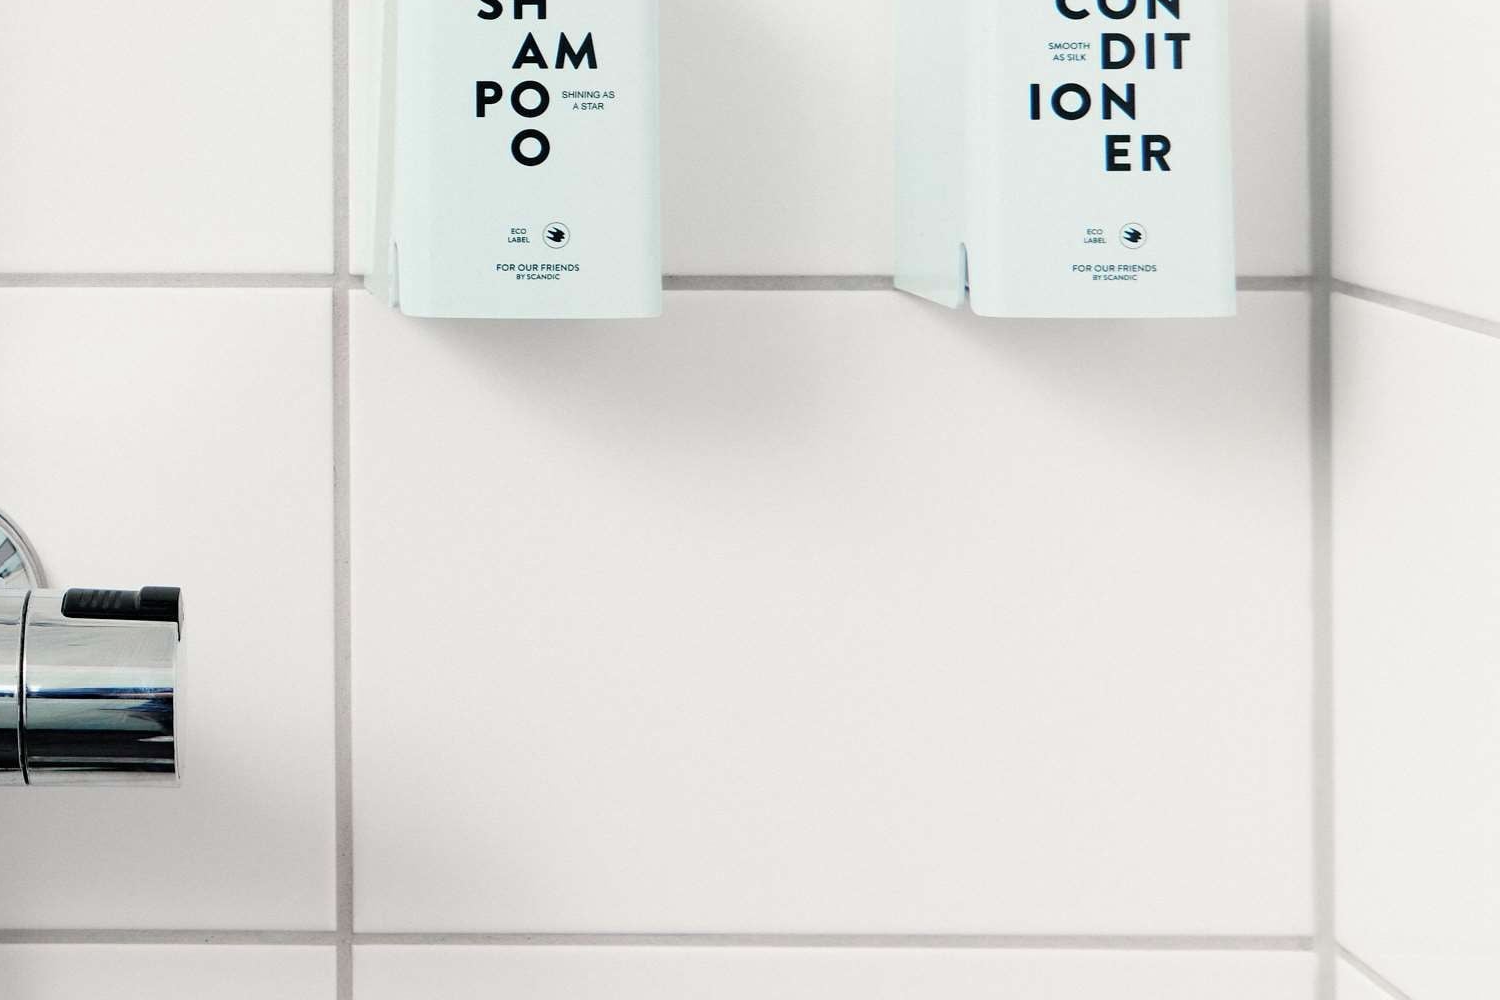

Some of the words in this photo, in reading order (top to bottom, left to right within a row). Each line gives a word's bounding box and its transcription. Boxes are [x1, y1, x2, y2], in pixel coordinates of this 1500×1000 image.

[512, 32, 598, 70] AM
[1048, 42, 1090, 50] SMOOTH
[1052, 53, 1065, 61] AS
[1067, 53, 1086, 61] SILK
[1101, 33, 1191, 70] DIT
[476, 80, 550, 118] PO
[561, 91, 600, 99] SHINING
[602, 91, 615, 99] AS
[572, 102, 579, 110] A
[581, 102, 604, 110] STAR
[1030, 83, 1136, 120] ION
[511, 129, 550, 167] O
[1105, 134, 1171, 171] ER
[496, 263, 515, 271] FOR
[518, 263, 538, 271] OUR
[541, 263, 580, 271] FRIENDS
[1072, 264, 1092, 272] FOR
[1094, 264, 1115, 272] OUR
[1118, 264, 1157, 272] FRIENDS
